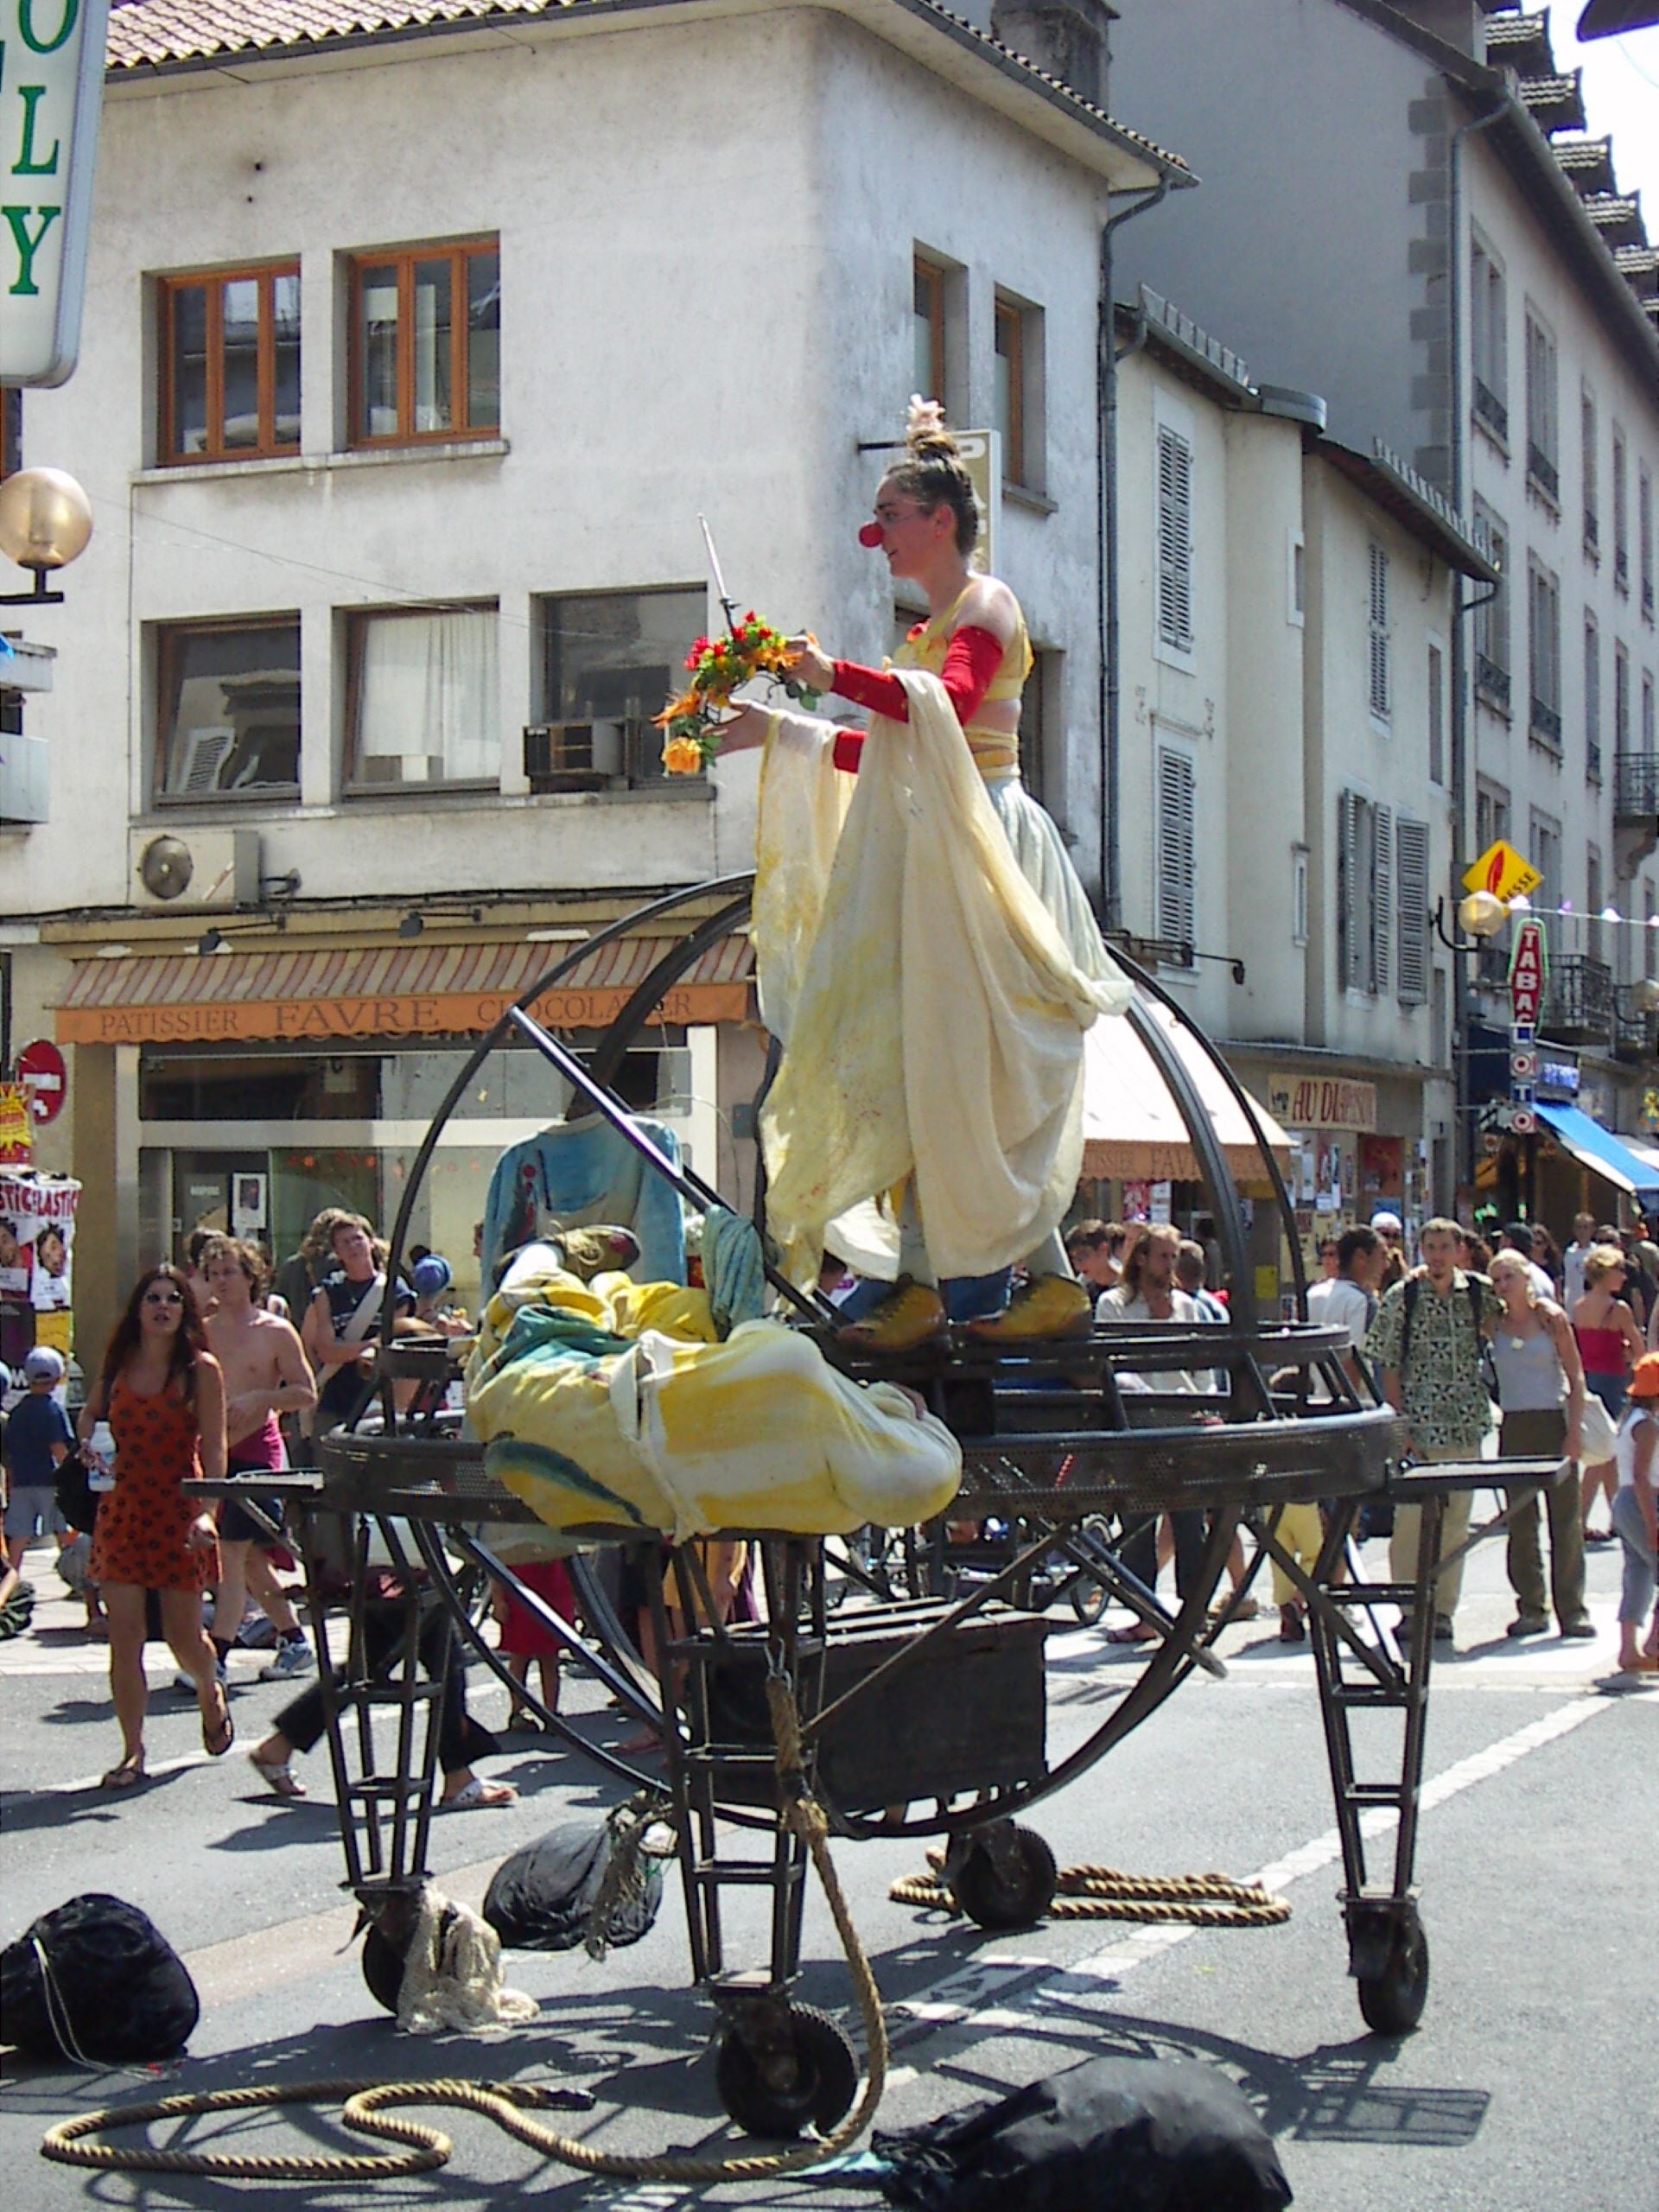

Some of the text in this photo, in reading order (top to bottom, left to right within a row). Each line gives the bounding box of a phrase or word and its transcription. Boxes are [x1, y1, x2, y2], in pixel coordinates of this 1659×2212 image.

[1499, 872, 1535, 905] RESSE
[101, 1009, 238, 1036] PATISSIER
[275, 1000, 439, 1032] FAVRE
